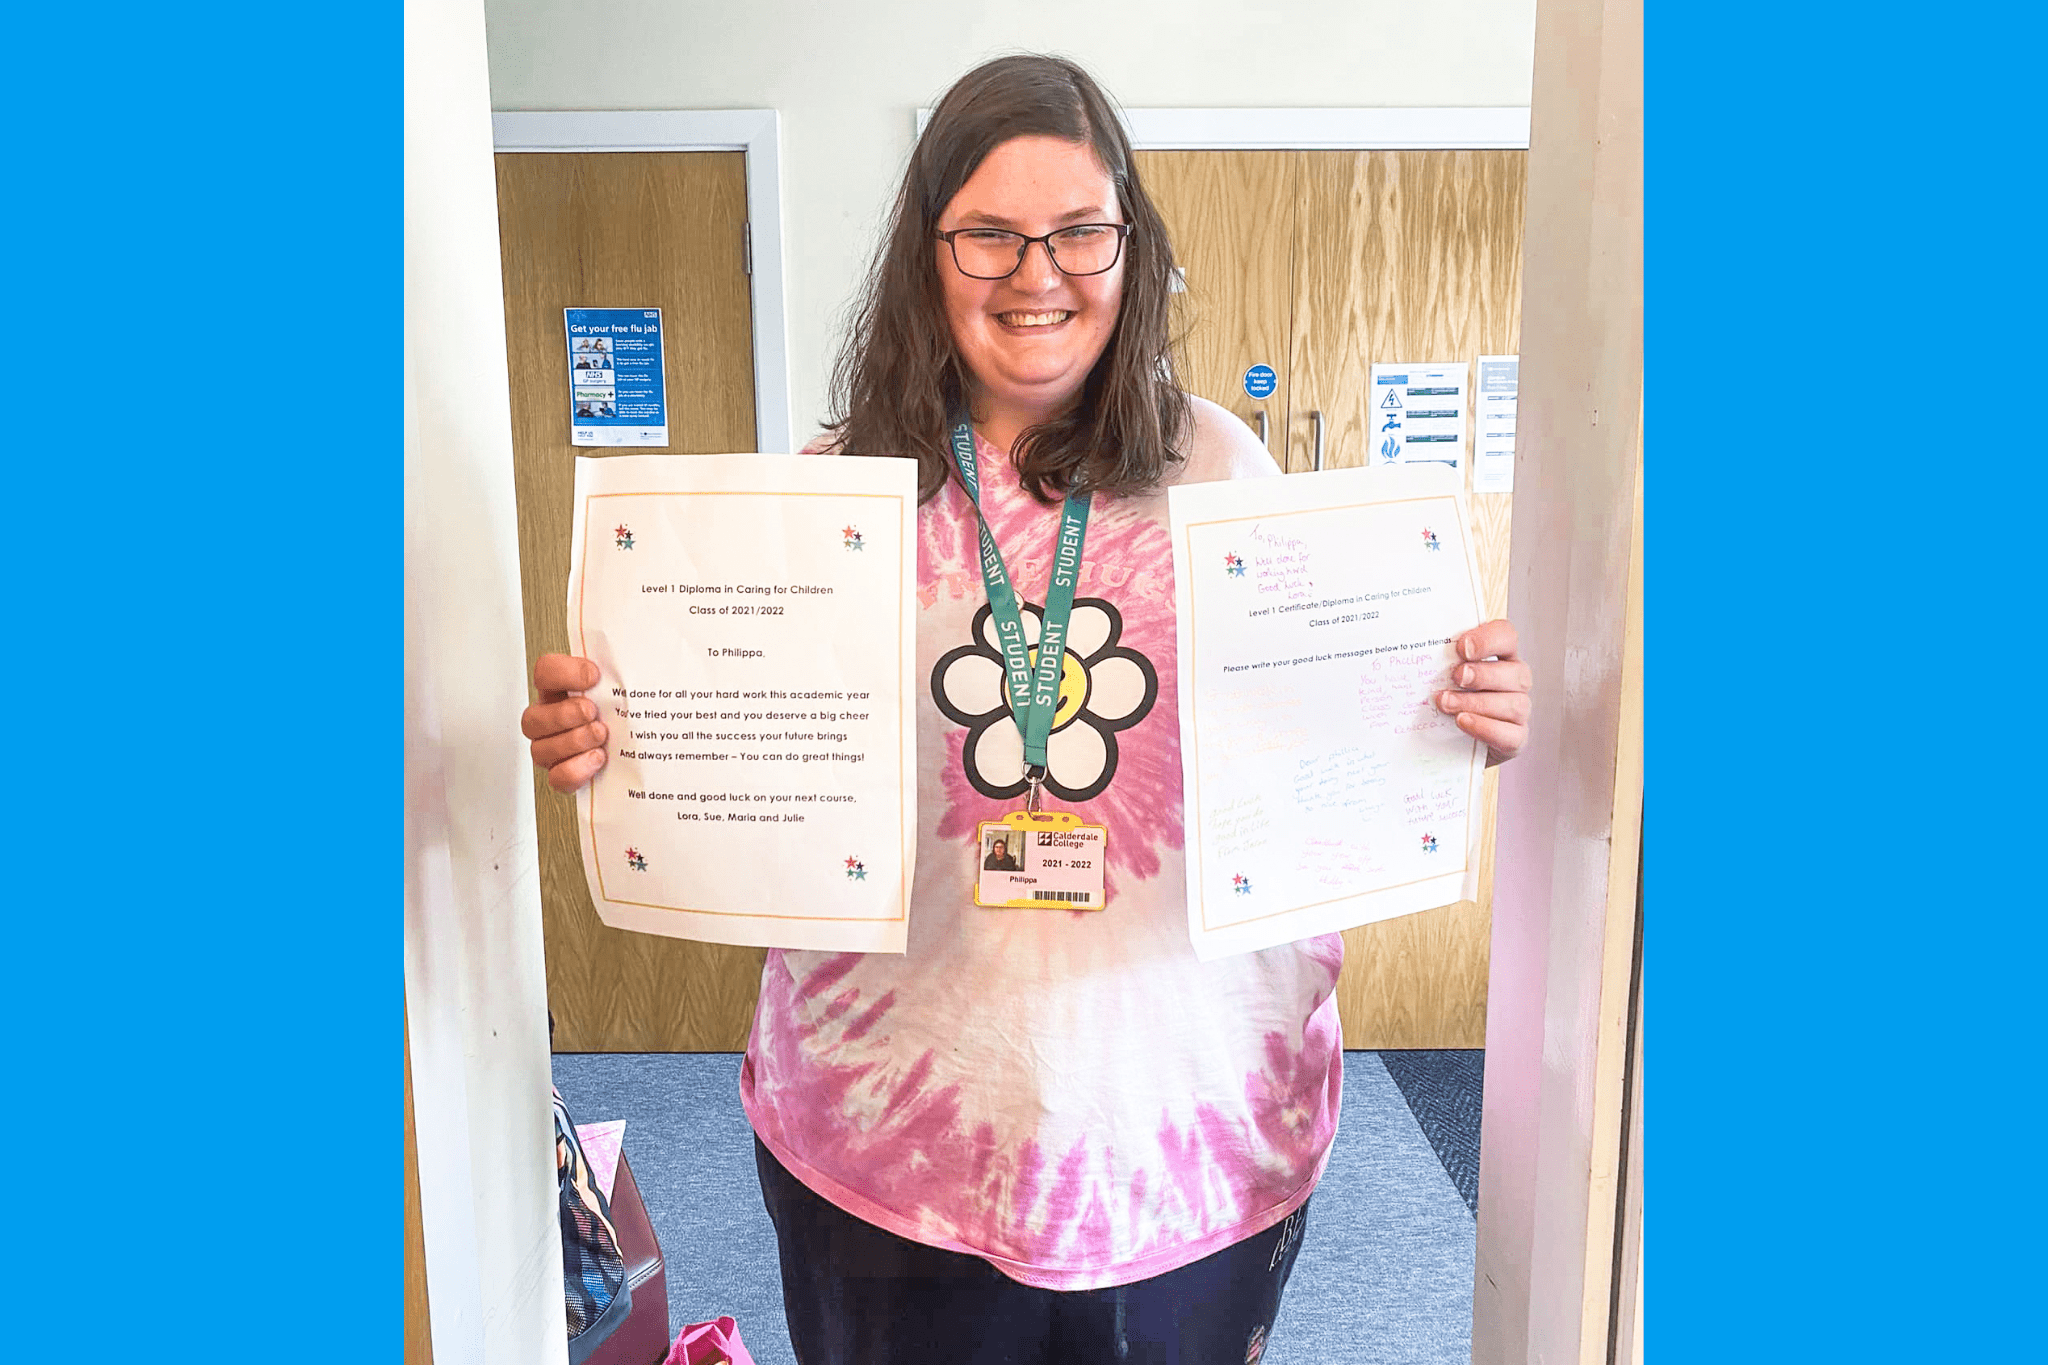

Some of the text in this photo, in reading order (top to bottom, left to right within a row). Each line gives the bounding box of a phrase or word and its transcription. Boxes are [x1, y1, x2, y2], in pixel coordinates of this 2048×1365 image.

[570, 324, 658, 334] Get your free flu jab
[954, 424, 978, 490] STUDENT
[980, 523, 1005, 586] TUDENT
[1056, 515, 1082, 587] STUDENT
[641, 583, 833, 596] Level 1 Diploma in Caring for Children
[1248, 607, 1270, 617] Level
[1278, 597, 1354, 613] Certificate/Diploma
[1364, 592, 1390, 602] Caring
[1391, 590, 1400, 598] for
[1402, 586, 1432, 596] Children
[688, 605, 784, 616] Class of 2021/2022
[1309, 611, 1380, 628] Class of 2021/2022
[707, 647, 719, 657] To
[1223, 664, 1249, 674] Please
[1251, 661, 1270, 670] write
[1272, 659, 1290, 669] your
[1291, 655, 1313, 667] good
[1315, 652, 1332, 662] luck
[1333, 648, 1373, 659] messages
[1374, 645, 1398, 654] below
[1399, 643, 1408, 651] to
[1409, 641, 1426, 651] your
[1001, 621, 1031, 707] STUDENT
[1036, 621, 1063, 707] STUDENT
[629, 689, 656, 698] done
[658, 688, 672, 698] for
[674, 689, 687, 698] all
[689, 691, 713, 700] your
[715, 689, 739, 699] hard
[742, 689, 767, 699] work
[769, 689, 787, 699] this
[789, 690, 843, 699] academic
[846, 692, 869, 701] year
[643, 709, 667, 719] tried
[669, 711, 693, 721] your
[695, 710, 717, 719] best
[719, 710, 740, 719] and
[743, 712, 763, 721] you
[765, 710, 807, 719] deserve
[819, 710, 836, 721] big
[838, 710, 869, 720] cheer
[629, 730, 847, 742] I wish you all the success your future brings
[619, 748, 635, 759] And
[637, 750, 672, 762] always
[674, 751, 728, 760] remember
[739, 751, 759, 760] You
[784, 751, 799, 760] do
[801, 751, 829, 763] great
[831, 751, 864, 763] things!
[627, 788, 646, 799] Well
[648, 790, 674, 800] done
[676, 791, 696, 801] and
[699, 792, 726, 803] good
[728, 792, 750, 801] luck
[769, 794, 791, 804] your
[794, 793, 816, 802] next
[727, 812, 756, 822] Maria
[758, 813, 779, 822] and
[781, 813, 805, 822] Julie
[1053, 832, 1098, 841] Calderdale
[1053, 840, 1084, 849] College
[1042, 860, 1062, 868] 2021
[1071, 860, 1092, 869] 2022
[1010, 876, 1038, 884] Philippa
